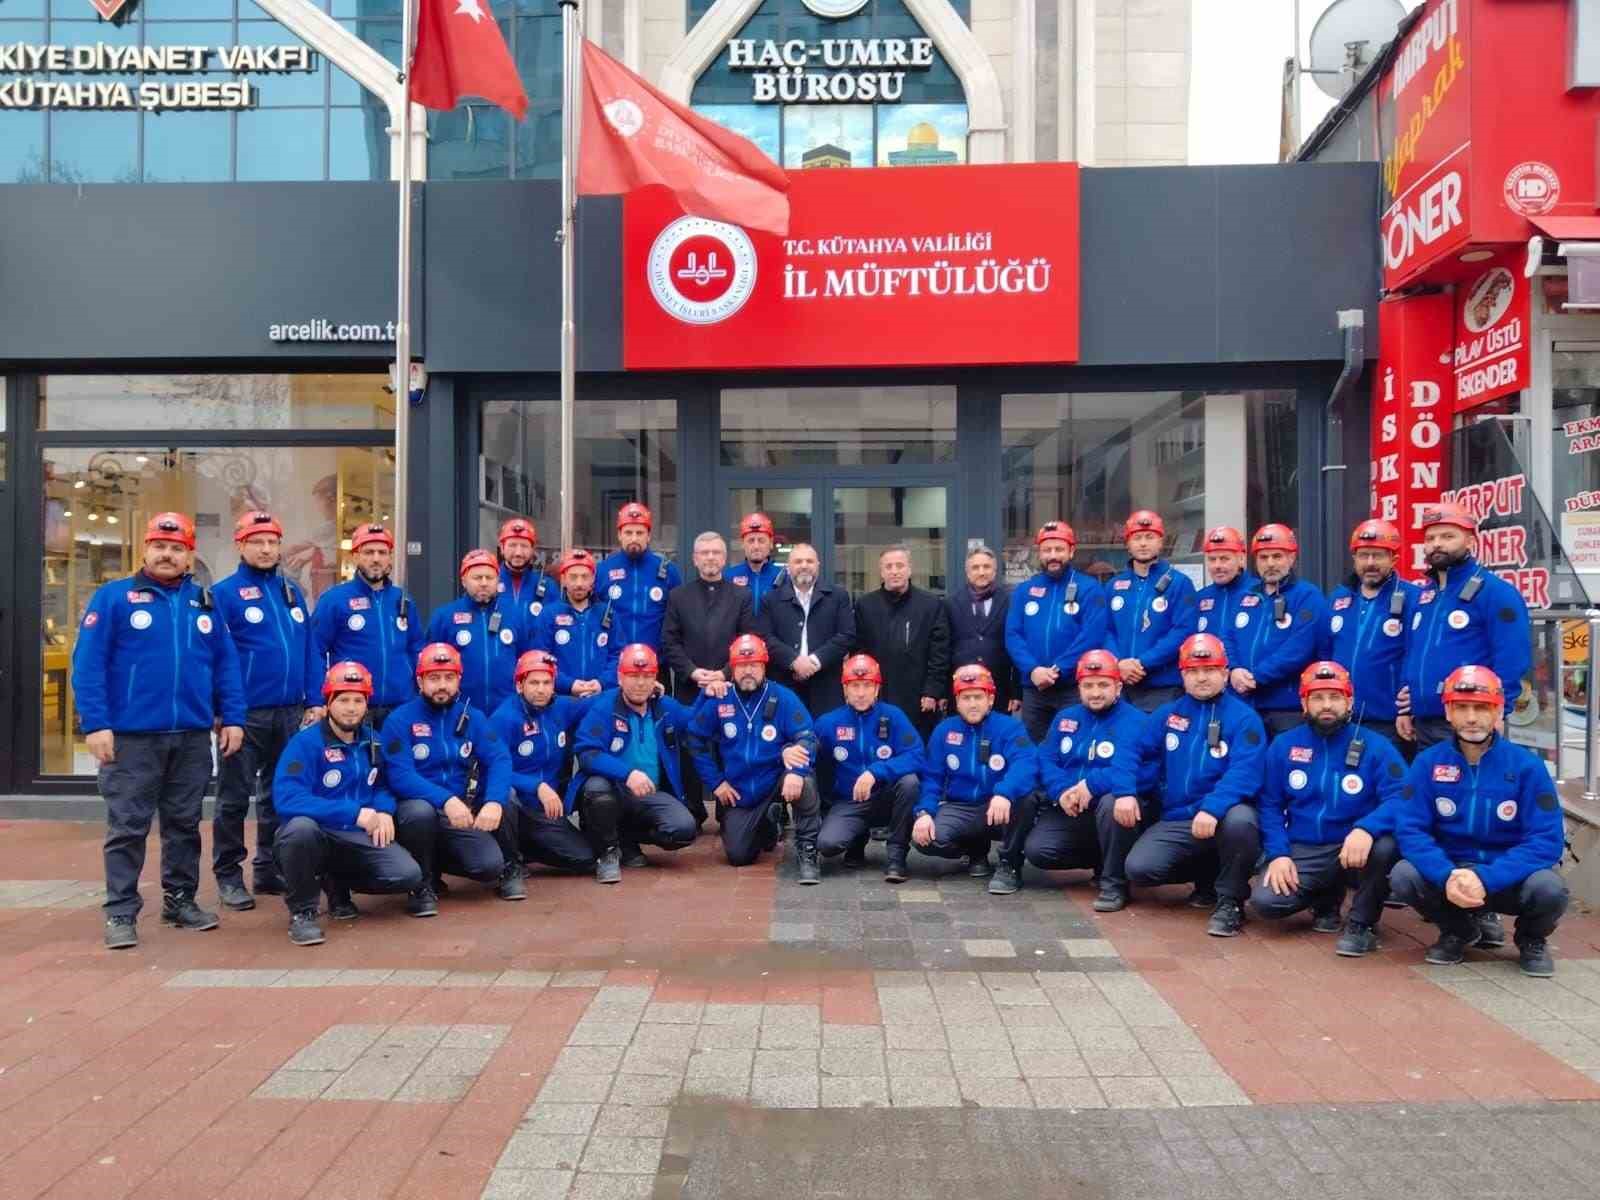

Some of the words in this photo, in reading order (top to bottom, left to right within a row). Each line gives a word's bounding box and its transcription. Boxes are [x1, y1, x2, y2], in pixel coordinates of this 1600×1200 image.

[0, 41, 66, 70] KİYE
[73, 41, 208, 70] DİYANET
[219, 45, 308, 70] VAKFI
[728, 38, 933, 66] HAC-UMRE
[0, 78, 132, 107] KÜTAHYA
[139, 78, 249, 110] ŞUBESİ
[753, 66, 905, 101] BÜROSU
[1519, 179, 1547, 197] HD
[784, 240, 814, 256] T.C.
[818, 236, 907, 255] KÜTAHYA
[912, 232, 992, 251] VALİLİĞİ
[784, 264, 816, 298] İL
[824, 257, 1051, 297] MÜFTÜLÜĞÜ
[269, 319, 400, 341] arcelik.com.t
[1454, 341, 1485, 367] PİLAV
[1487, 317, 1521, 353] ÜSTÜ
[1457, 356, 1517, 401] İSKENDER
